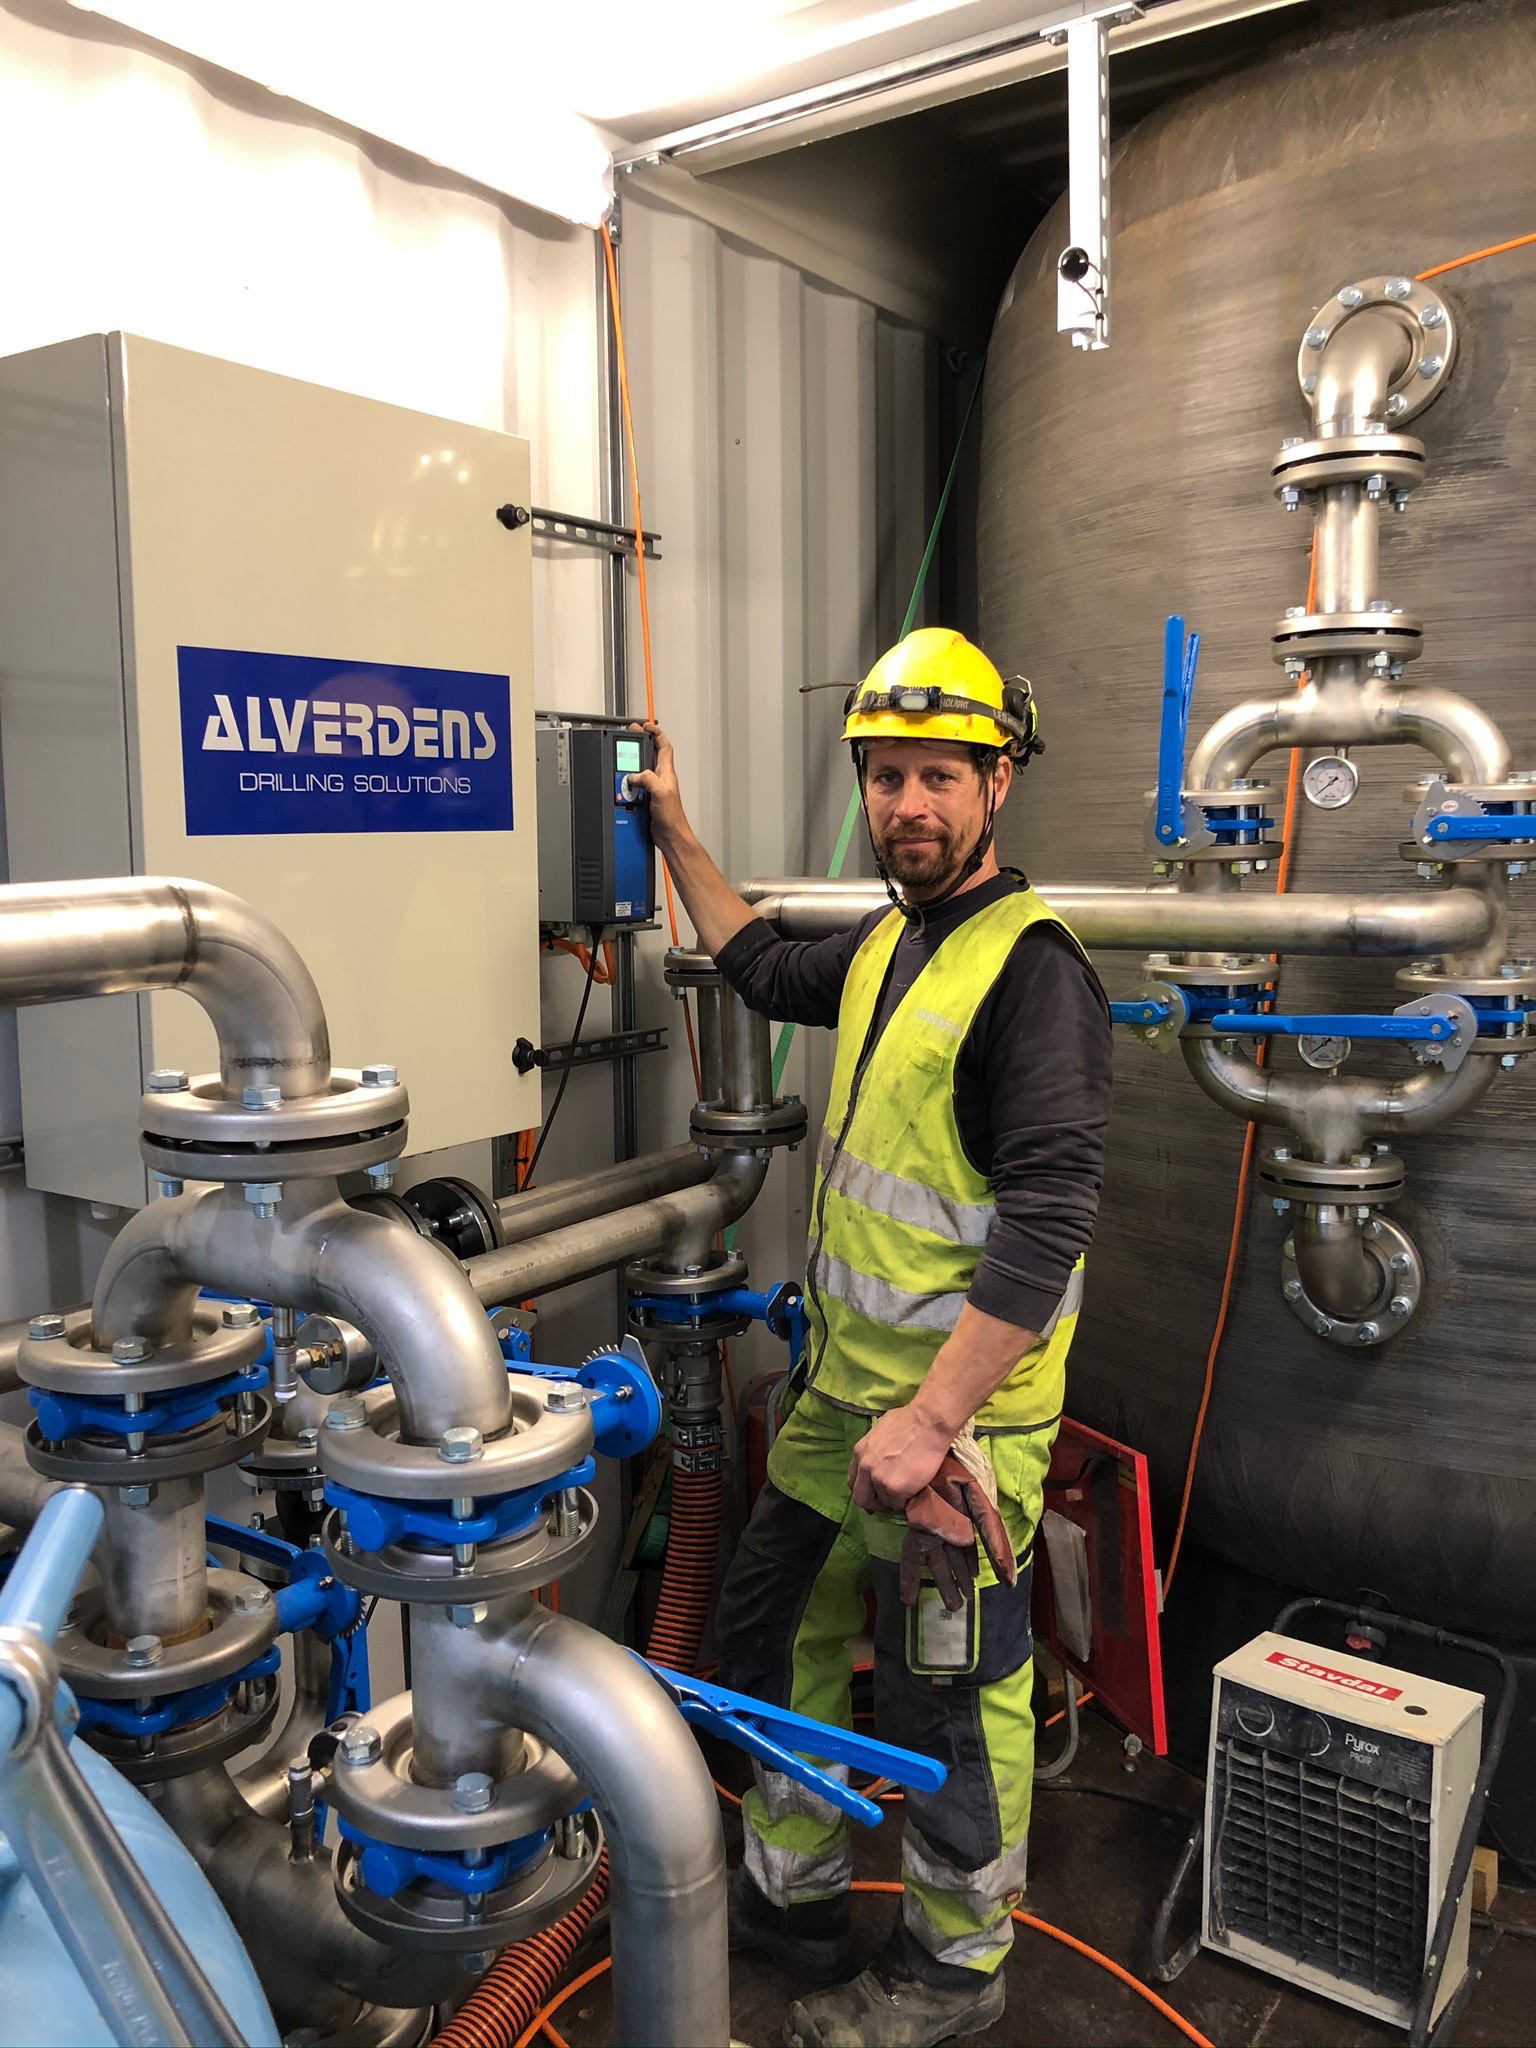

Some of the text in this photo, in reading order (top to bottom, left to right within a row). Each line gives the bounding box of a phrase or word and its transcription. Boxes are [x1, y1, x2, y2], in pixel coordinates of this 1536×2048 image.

[201, 694, 497, 760] ALVERDENS
[239, 772, 472, 794] DRILLING SOLUTIONS
[1278, 1657, 1388, 1695] Stavdal
[1345, 1732, 1380, 1756] Pyrox
